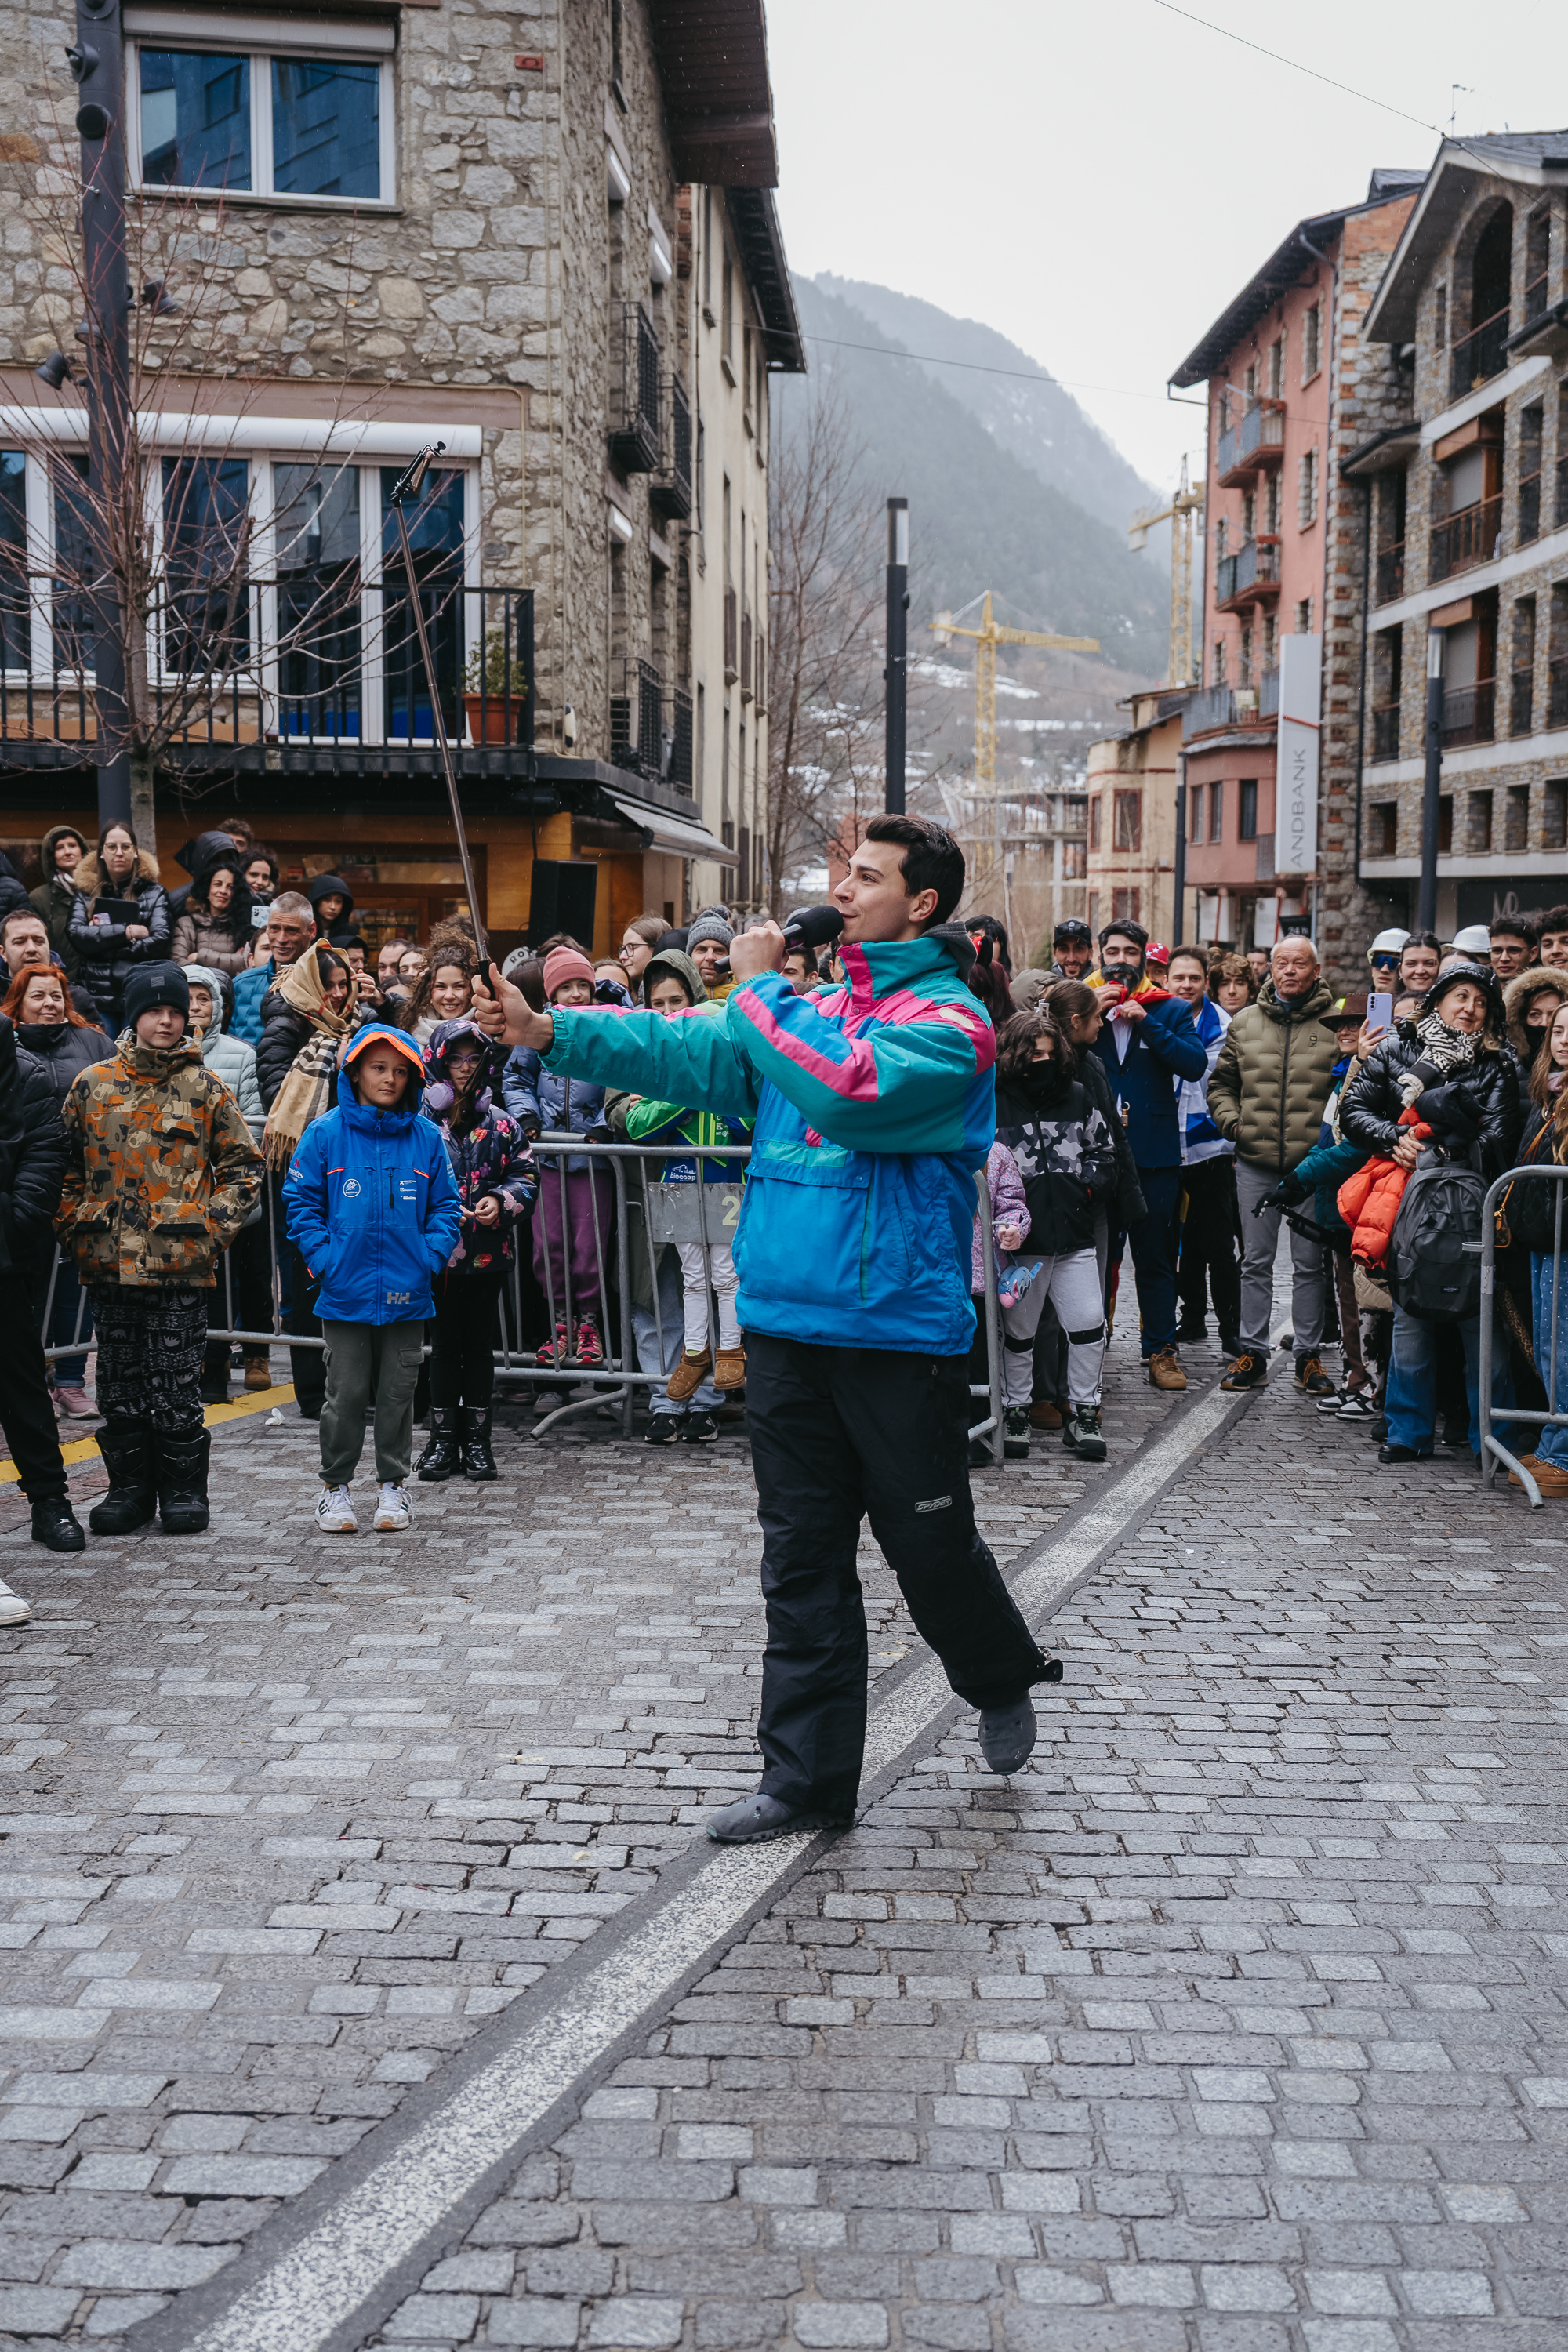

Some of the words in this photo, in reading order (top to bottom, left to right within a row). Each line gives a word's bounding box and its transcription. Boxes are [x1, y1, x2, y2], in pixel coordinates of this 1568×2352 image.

[1291, 748, 1307, 869] ANDBANK
[721, 1195, 741, 1226] 2
[387, 1291, 410, 1304] HH
[917, 1497, 951, 1511] SPYDER
